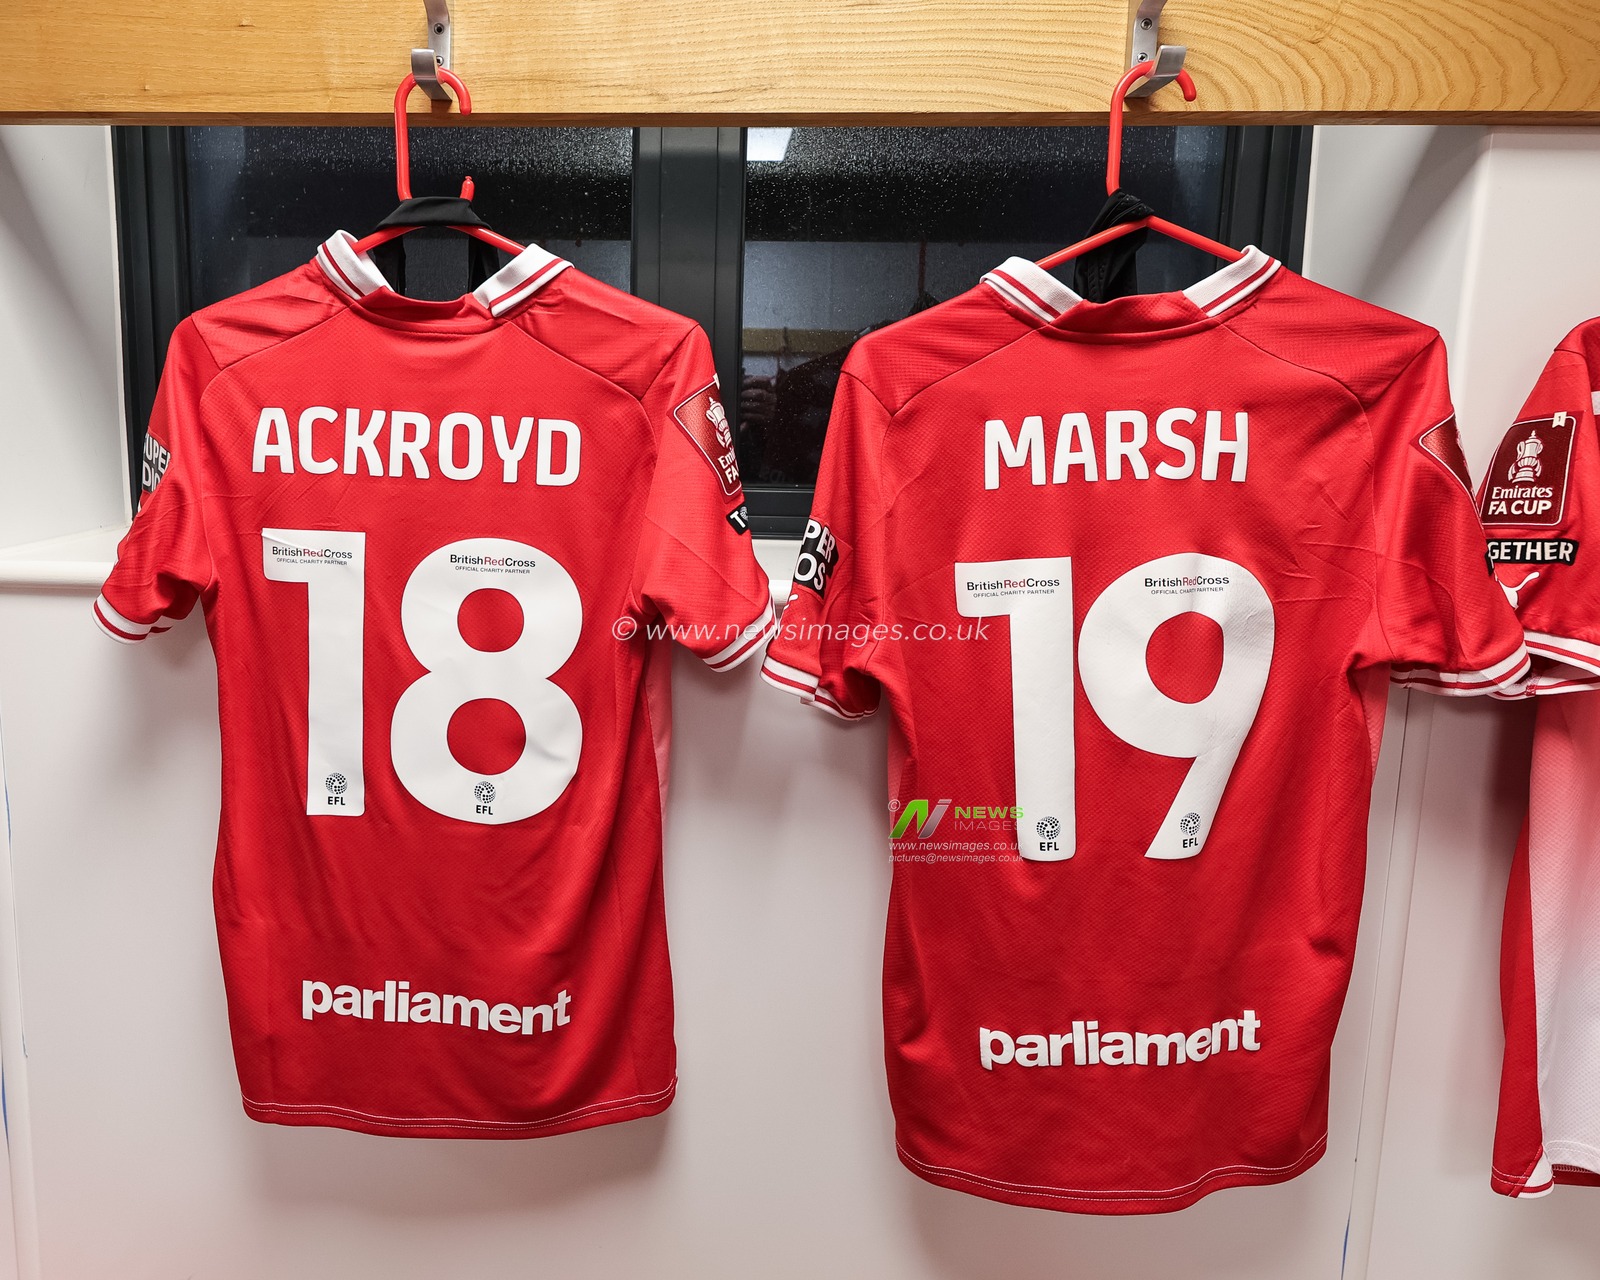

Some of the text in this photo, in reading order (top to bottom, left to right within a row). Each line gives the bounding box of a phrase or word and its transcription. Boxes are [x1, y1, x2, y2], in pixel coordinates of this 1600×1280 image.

[253, 407, 581, 486] ACKROYD
[984, 407, 1249, 490] MARSH
[1491, 485, 1553, 500] Emirates
[1488, 500, 1552, 515] FA CUP
[272, 546, 353, 559] BritishRedCross
[450, 554, 536, 567] BritishRedCross
[966, 578, 1060, 591] BritishRedCross
[1144, 575, 1230, 588] BritishRedCross
[261, 527, 584, 825] 18
[954, 552, 1275, 862] 19
[327, 796, 346, 806] EFL
[475, 804, 493, 816] EFL
[1039, 841, 1060, 852] EFL
[1182, 837, 1199, 849] EFL
[302, 980, 572, 1035] parliament
[979, 1009, 1261, 1071] parliament
